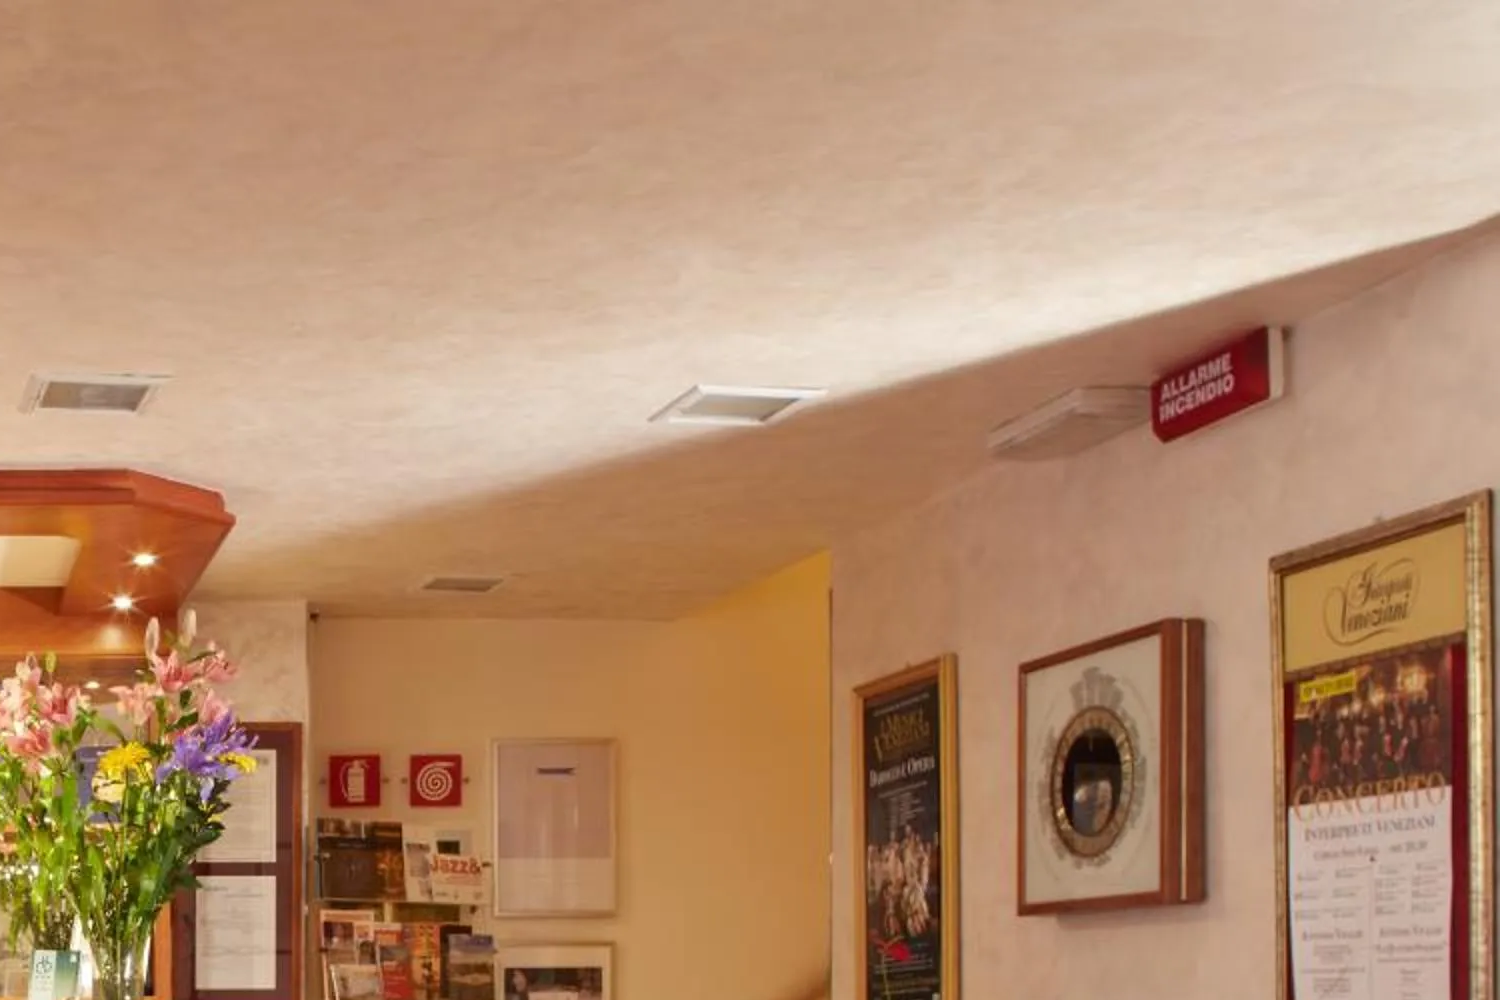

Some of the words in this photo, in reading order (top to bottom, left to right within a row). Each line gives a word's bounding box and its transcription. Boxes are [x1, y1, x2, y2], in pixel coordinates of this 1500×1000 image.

[1159, 373, 1235, 424] INCENDIO
[1160, 352, 1233, 402] ALLARME
[1294, 771, 1446, 822] CONCERTO
